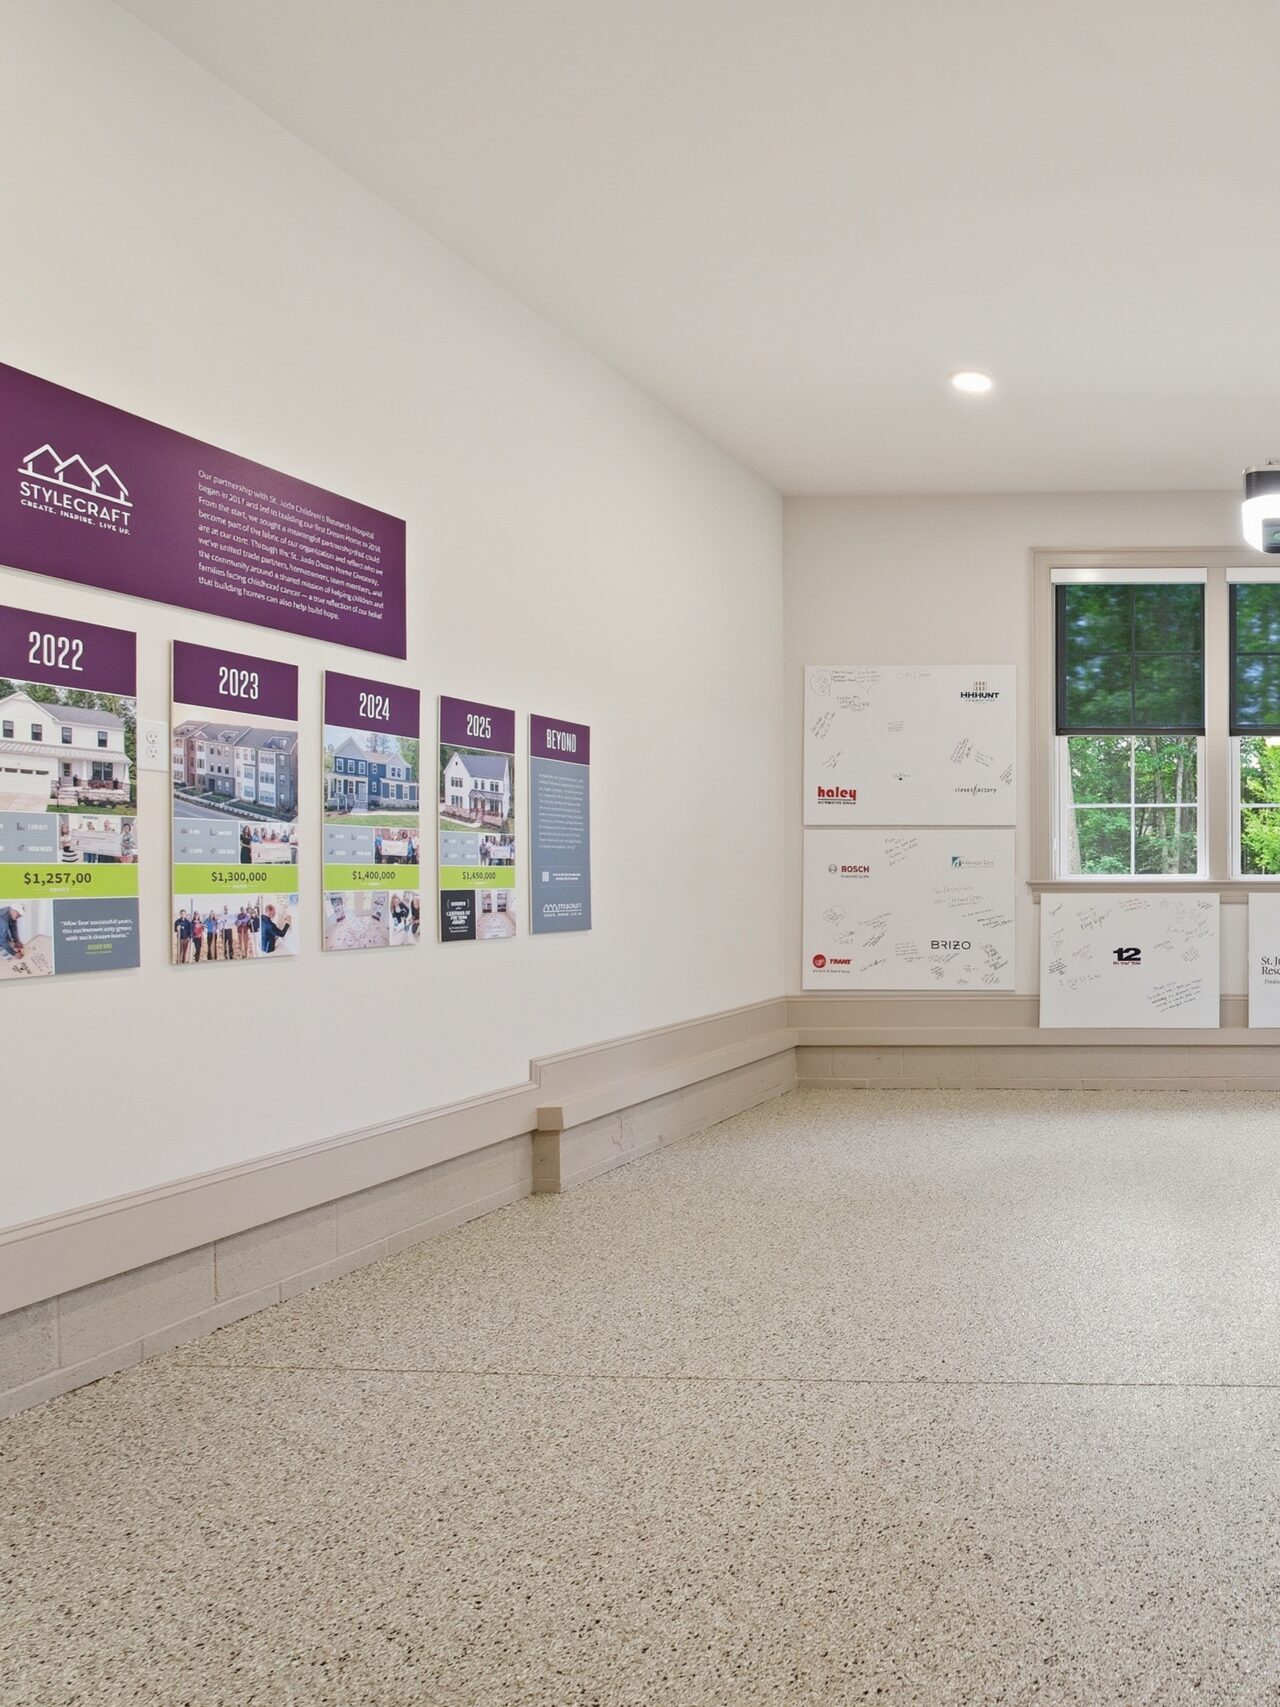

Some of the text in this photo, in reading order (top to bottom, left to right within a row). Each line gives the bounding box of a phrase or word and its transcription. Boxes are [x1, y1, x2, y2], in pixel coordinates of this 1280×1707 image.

[20, 481, 131, 526] STYLECRAFT
[20, 499, 131, 535] CREATE. INSPIRE. LIVE UP.
[199, 470, 212, 480] Our
[214, 476, 252, 496] partnership
[254, 490, 268, 501] with
[269, 496, 278, 505] St.
[295, 505, 325, 521] Children's
[326, 516, 352, 531] Research
[352, 526, 375, 540] Hospital
[199, 482, 220, 496] began
[246, 501, 258, 510] and
[278, 510, 303, 527] building
[327, 528, 345, 539] Dream
[199, 496, 217, 508] From
[219, 504, 229, 513] the
[231, 509, 247, 520] start,
[259, 518, 280, 530] sought
[321, 540, 353, 555] partnership
[199, 509, 226, 525] become
[228, 520, 241, 530] part
[262, 530, 279, 542] fabric
[299, 544, 334, 560] organization
[335, 555, 346, 564] and
[199, 524, 210, 533] are
[233, 535, 250, 545] core.
[251, 539, 278, 555] Through
[315, 560, 334, 571] Dream
[199, 537, 219, 549] we've
[220, 544, 241, 556] united
[243, 550, 260, 561] trade
[199, 550, 210, 560] the
[211, 554, 250, 572] community
[250, 566, 273, 577] around
[280, 574, 300, 585] shared
[331, 588, 351, 602] helping
[199, 562, 225, 577] families
[226, 570, 246, 584] facing
[247, 577, 279, 592] childhood
[313, 596, 325, 605] true
[199, 576, 213, 587] that
[214, 581, 242, 596] building
[243, 588, 265, 600] homes
[266, 595, 278, 604] can
[279, 598, 292, 608] also
[293, 601, 306, 612] help
[307, 604, 322, 616] build
[29, 631, 83, 671] 2022
[219, 667, 258, 699] 2023
[360, 693, 390, 720] 2024
[467, 714, 491, 738] 2025
[546, 729, 576, 753] BEYOND
[818, 786, 856, 801] haley
[24, 872, 91, 886] $1,257,00
[211, 871, 267, 883] $1,300,000
[352, 870, 395, 880] $1,400,000
[931, 940, 971, 950] BRIZO
[1113, 948, 1141, 961] 12
[1261, 956, 1272, 965] St.
